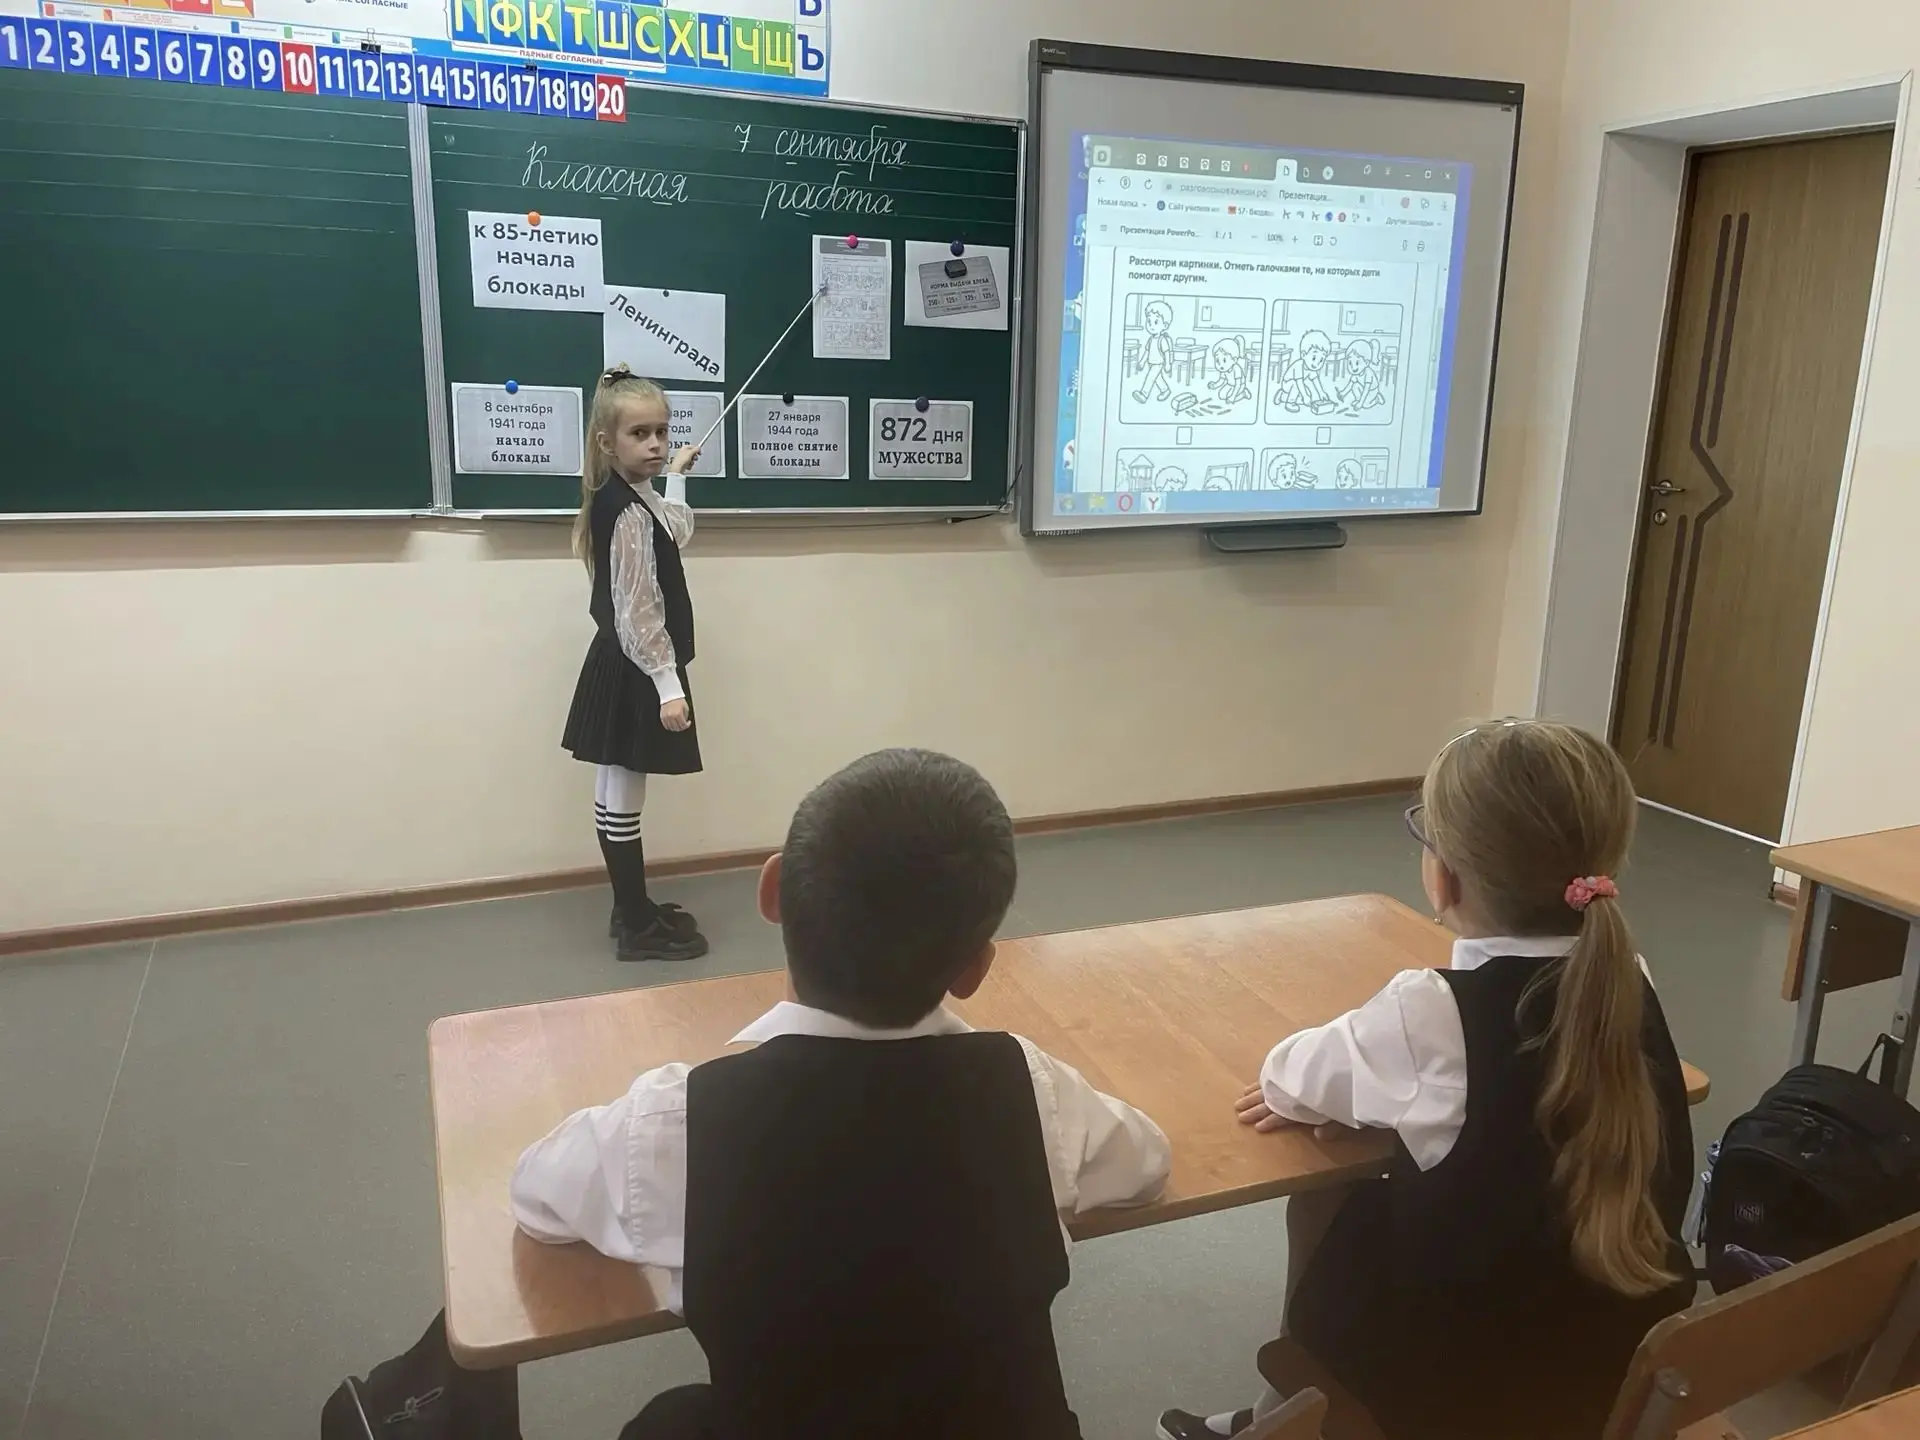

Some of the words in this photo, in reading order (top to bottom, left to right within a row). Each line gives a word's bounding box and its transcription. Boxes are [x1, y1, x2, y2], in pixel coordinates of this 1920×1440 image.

[455, 0, 484, 34] П
[490, 0, 523, 38] Ф
[529, 1, 557, 42] К
[564, 5, 591, 45] Т
[597, 10, 629, 50] Ш
[635, 15, 660, 54] С
[668, 18, 695, 58] Х
[701, 23, 728, 67] Ц
[736, 27, 760, 64] Ч
[765, 30, 793, 74] Щ
[519, 49, 553, 59] ПАРНЫЕ
[555, 54, 604, 65] СОГЛАСНЫЕ
[798, 34, 824, 71] Ъ
[2, 26, 18, 61] 1
[35, 28, 55, 64] 2
[68, 31, 86, 67] 3
[101, 35, 121, 69] 4
[133, 37, 150, 72] 5
[165, 40, 183, 75] 6
[197, 43, 213, 77] 7
[227, 46, 246, 80] 8
[259, 48, 276, 83] 9
[284, 52, 313, 87] 10
[319, 55, 346, 90] 11
[352, 58, 381, 93] 12
[385, 61, 412, 96] 13
[417, 64, 446, 99] 14
[449, 66, 476, 101] 15
[480, 69, 506, 104] 16
[510, 72, 535, 107] 17
[540, 75, 566, 110] 18
[570, 78, 594, 113] 19
[598, 81, 624, 115] 20
[734, 124, 751, 153] 7
[775, 125, 908, 182] сентября
[521, 140, 689, 203] Классная
[760, 170, 895, 220] работа
[474, 224, 487, 239] к
[492, 222, 599, 247] 85-летию
[497, 250, 575, 268] начала
[1129, 255, 1177, 268] Рассмотри
[1179, 260, 1222, 270] картинки.
[1256, 264, 1300, 273] галочками
[1327, 268, 1360, 277] которых
[1128, 271, 1172, 281] помогают
[1173, 273, 1208, 284] другим.
[487, 275, 585, 300] блокады
[609, 293, 720, 377] Ленинграда
[484, 402, 492, 413] 8
[495, 403, 553, 417] сентября
[768, 411, 781, 421] 27
[783, 412, 821, 423] января
[489, 418, 515, 429] 1941
[518, 420, 546, 431] года
[669, 425, 692, 435] ода
[767, 425, 792, 435] 1944
[794, 427, 819, 437] года
[880, 417, 927, 442] 872
[932, 430, 963, 444] дня
[495, 435, 544, 447] начало
[751, 442, 795, 452] полное
[797, 442, 839, 452] снятие
[491, 450, 550, 463] блокады
[770, 456, 821, 468] блокады
[878, 450, 963, 468] мужества
